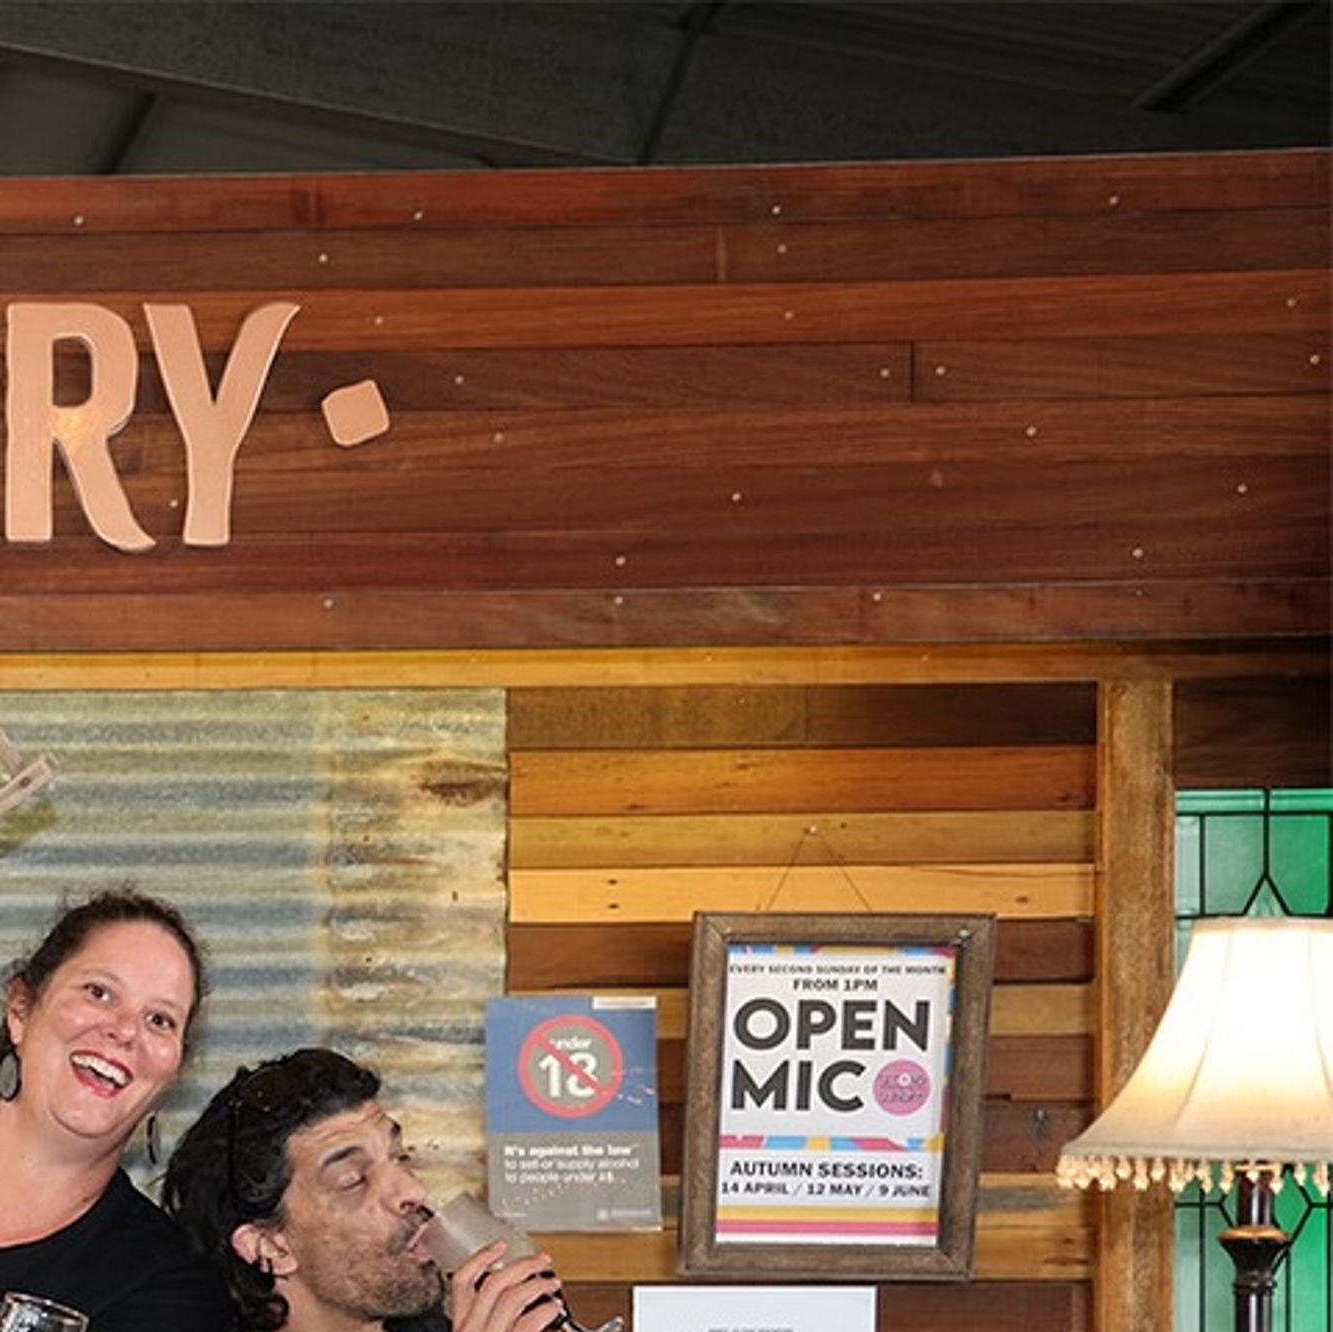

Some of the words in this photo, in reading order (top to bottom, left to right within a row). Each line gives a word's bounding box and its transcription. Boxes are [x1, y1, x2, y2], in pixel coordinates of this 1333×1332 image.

[729, 965, 764, 974] EVERY
[768, 965, 813, 974] SECOND
[816, 965, 860, 974] SUNDAY
[864, 965, 878, 974] OF
[882, 965, 902, 974] THE
[905, 966, 946, 975] MONTH
[793, 978, 838, 991] FROM
[843, 978, 878, 991] 1PM
[734, 997, 931, 1052] OPEN
[538, 1052, 598, 1098] 18
[730, 1058, 867, 1113] MIC
[729, 1160, 813, 1178] AUTUMN
[818, 1162, 924, 1180] SESSIONS:
[721, 1182, 739, 1194] 14
[743, 1182, 789, 1195] APRIL
[807, 1183, 826, 1195] 12
[830, 1184, 862, 1196] MAY
[880, 1185, 889, 1196] 9
[891, 1185, 932, 1197] JUNE
